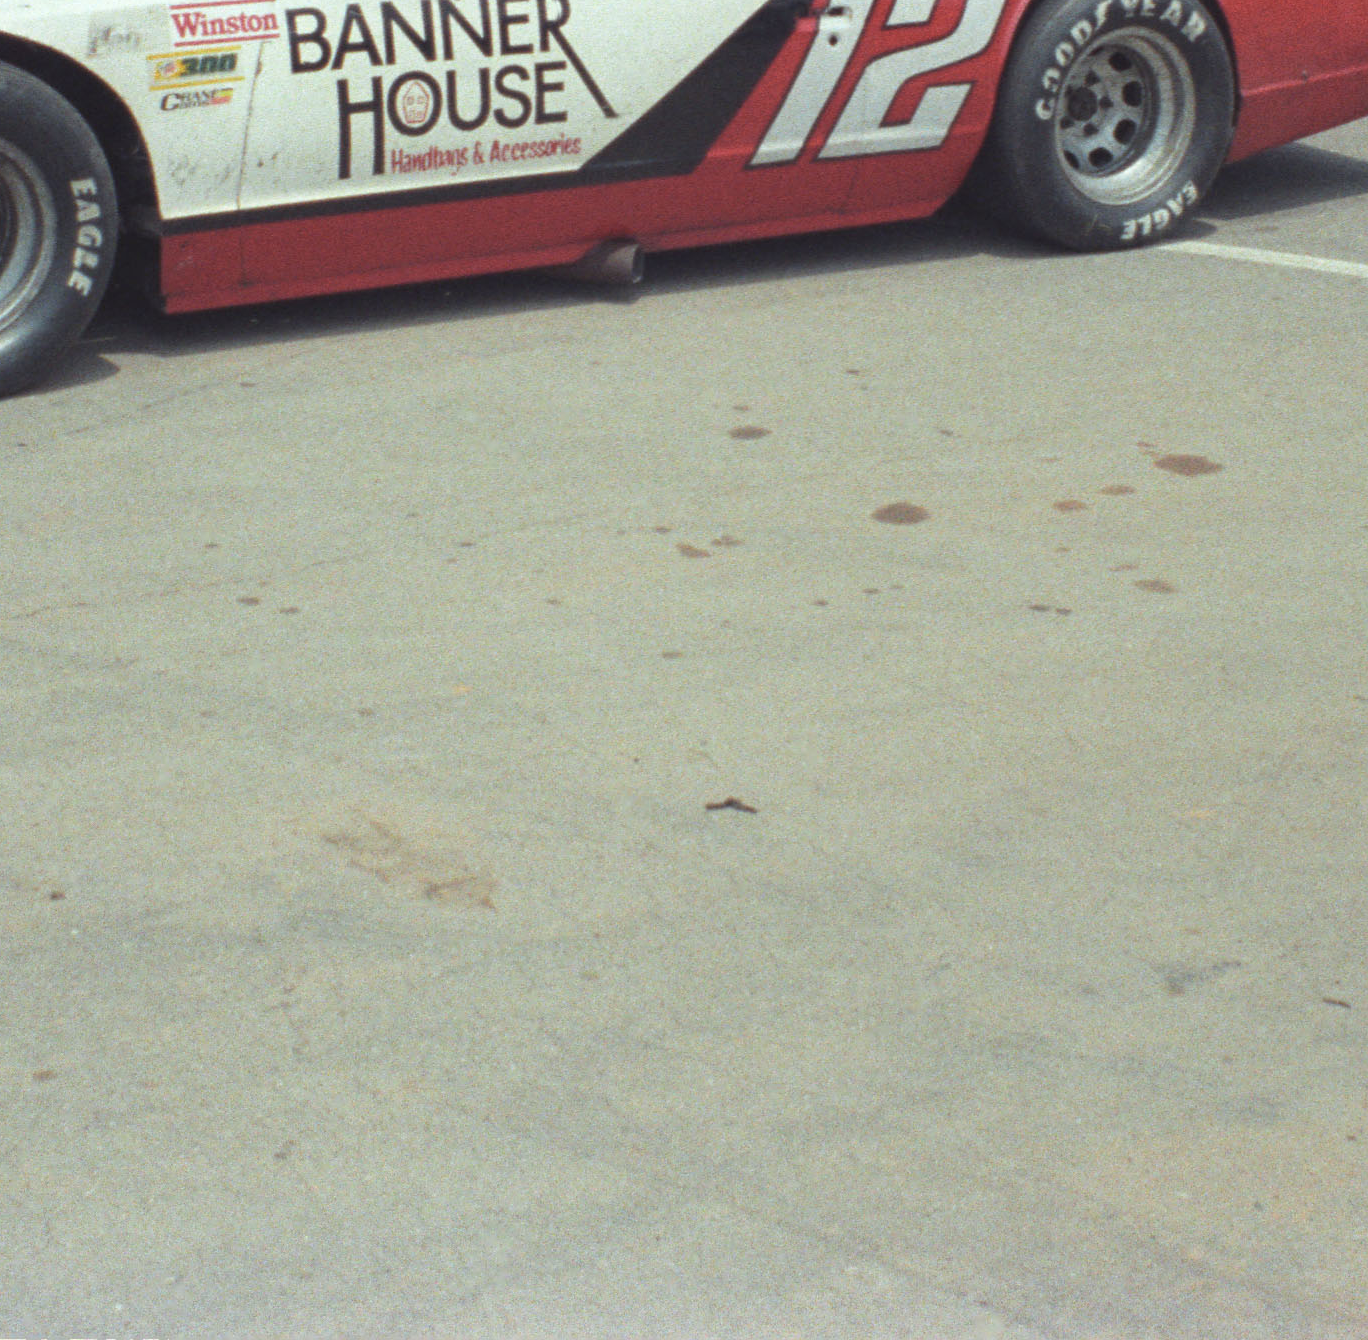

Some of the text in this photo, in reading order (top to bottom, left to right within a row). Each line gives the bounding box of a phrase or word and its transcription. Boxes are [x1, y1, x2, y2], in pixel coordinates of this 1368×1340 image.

[170, 11, 280, 38] Winston
[335, 60, 569, 180] HOUSE
[391, 140, 469, 176] Handbags
[489, 132, 582, 163] Accessories
[67, 177, 104, 298] EAGLE
[1120, 180, 1199, 241] EAGLE
